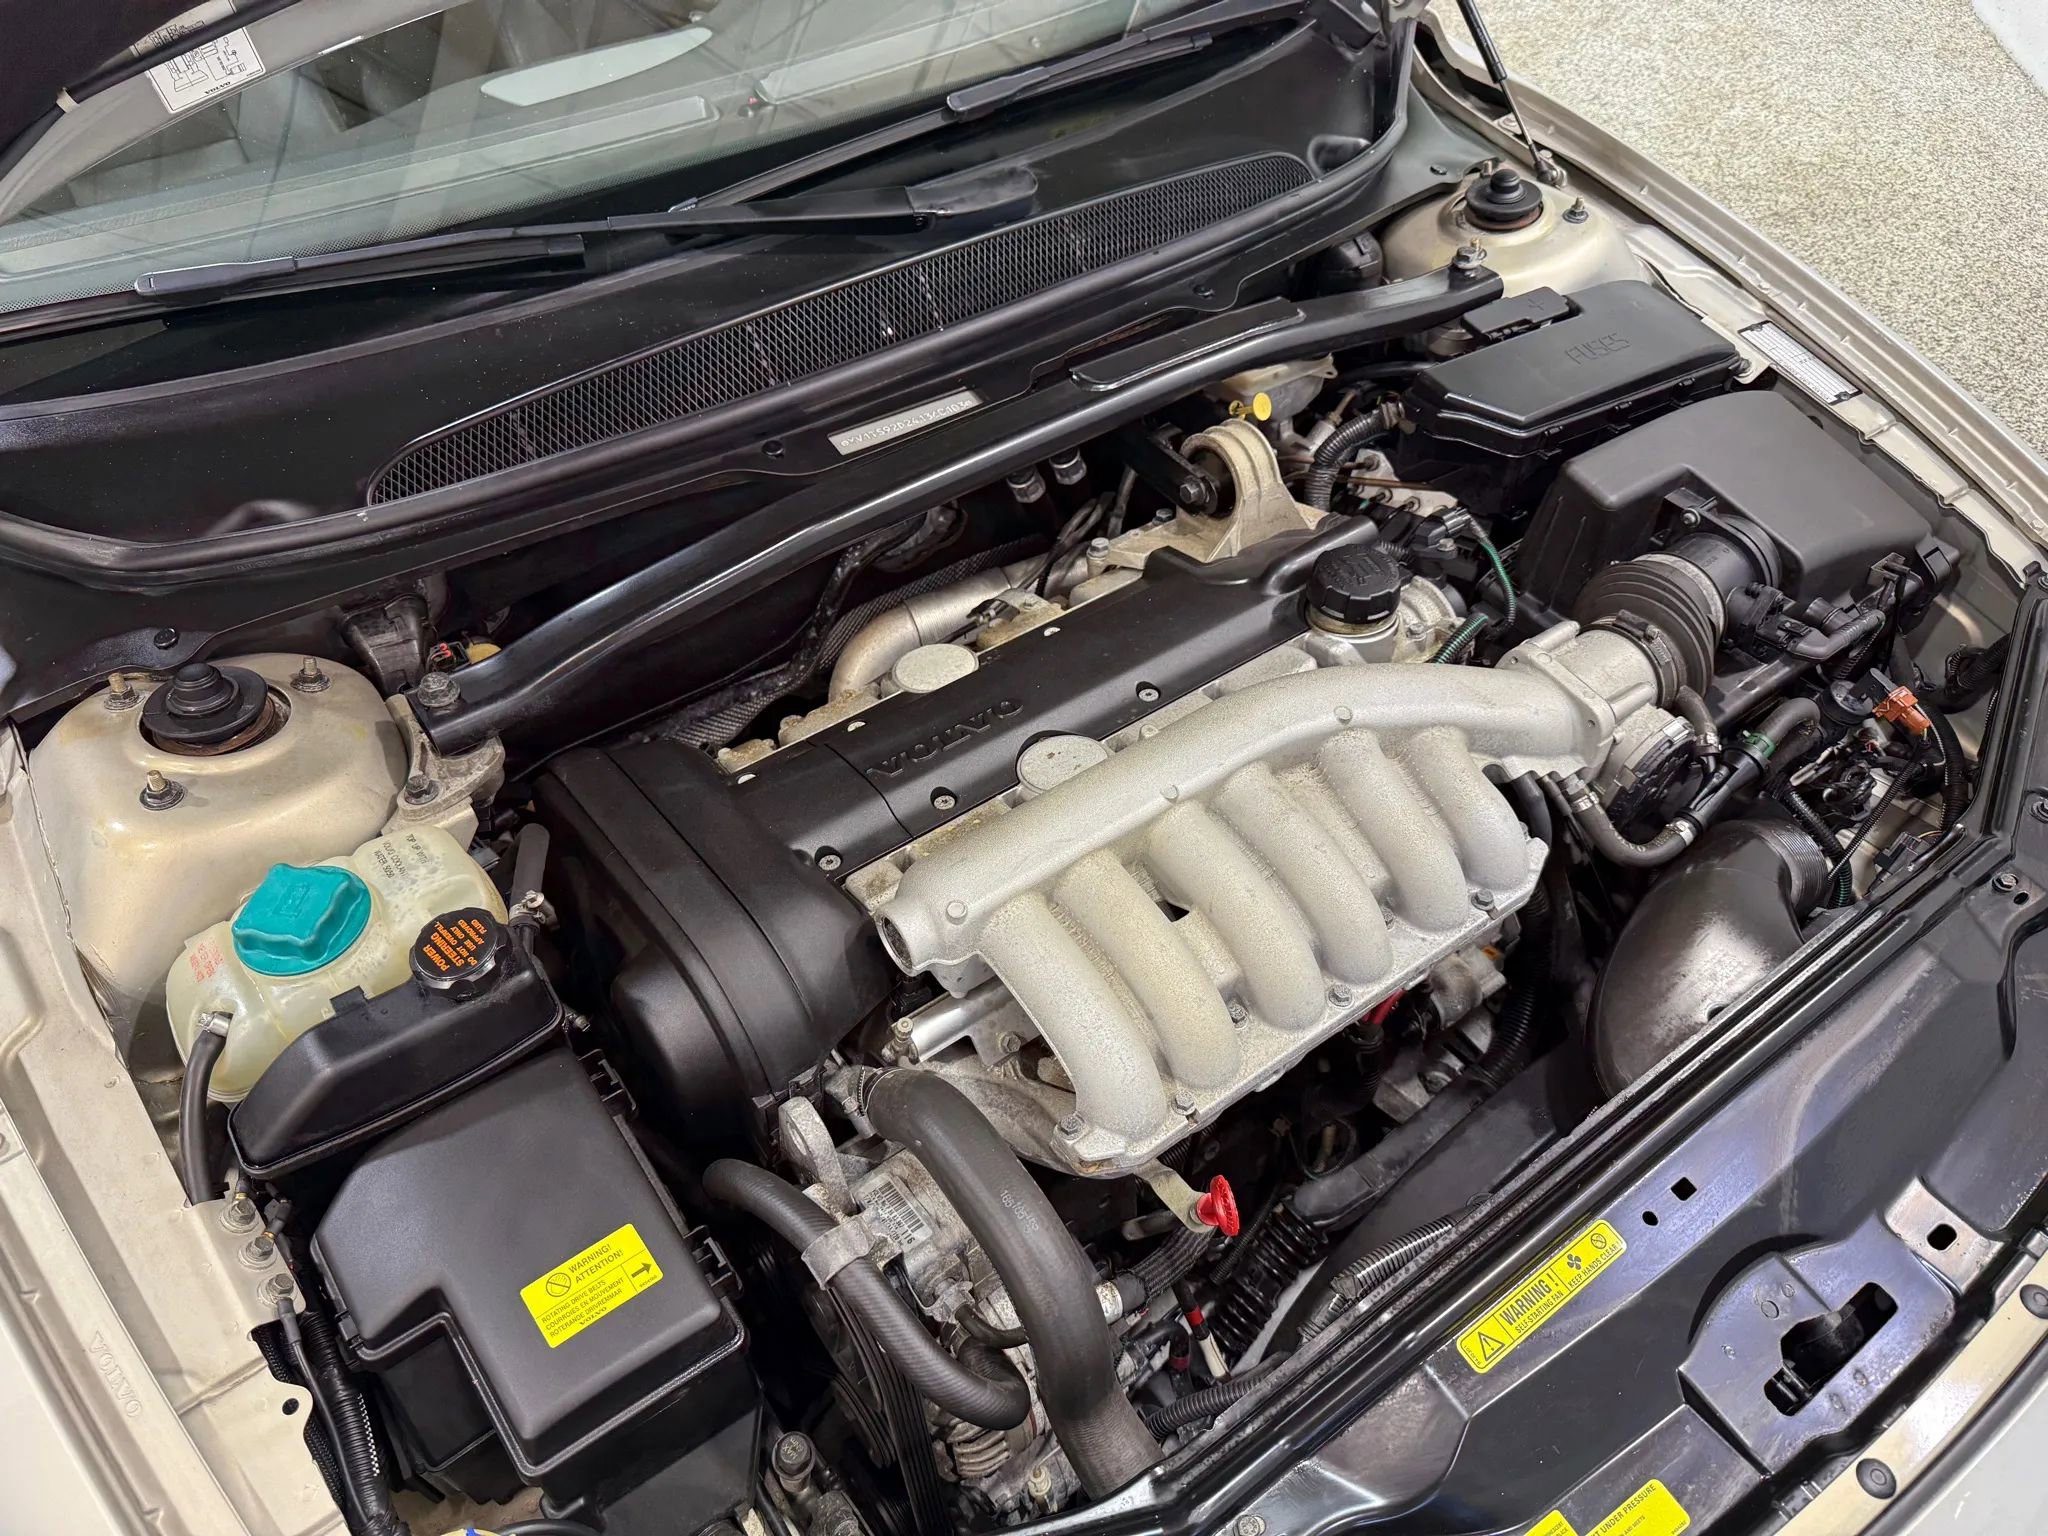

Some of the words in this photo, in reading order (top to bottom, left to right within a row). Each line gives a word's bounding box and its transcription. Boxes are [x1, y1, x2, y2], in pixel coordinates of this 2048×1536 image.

[204, 81, 231, 95] VOLVO
[1564, 332, 1630, 365] FUSES
[866, 700, 1024, 777] VOLVO
[450, 926, 465, 939] ONLY
[458, 919, 485, 945] APPROVED
[471, 919, 487, 934] FLUID
[423, 944, 450, 971] POWER
[430, 932, 465, 967] STEERING
[456, 946, 469, 957] NOT
[464, 939, 476, 951] USE
[467, 956, 478, 966] DO
[900, 1228, 916, 1245] 116
[568, 1243, 612, 1273] WARNING!
[575, 1249, 624, 1284] ATTENTION!
[1567, 1274, 1582, 1288] KEEP
[1583, 1259, 1601, 1277] HANDS
[541, 1301, 571, 1324] ROTATING
[571, 1290, 588, 1305] DRIVE
[588, 1280, 606, 1296] BELTS
[545, 1306, 579, 1331] COURROIES
[580, 1298, 589, 1308] EN
[589, 1277, 624, 1301] MOUVEMENT
[549, 1311, 585, 1338] ROTERANDE
[585, 1288, 622, 1315] DRIVREMMAR
[579, 1306, 607, 1326] VOLVO
[1500, 1278, 1552, 1326] WARNING
[1515, 1298, 1554, 1334] SELF-STARTING
[1553, 1290, 1565, 1304] FAN
[89, 1330, 143, 1417] VOLVO
[1600, 1511, 1625, 1534] UNDER
[1622, 1483, 1656, 1514] PRESSURE
[1632, 1515, 1646, 1527] MEETS
